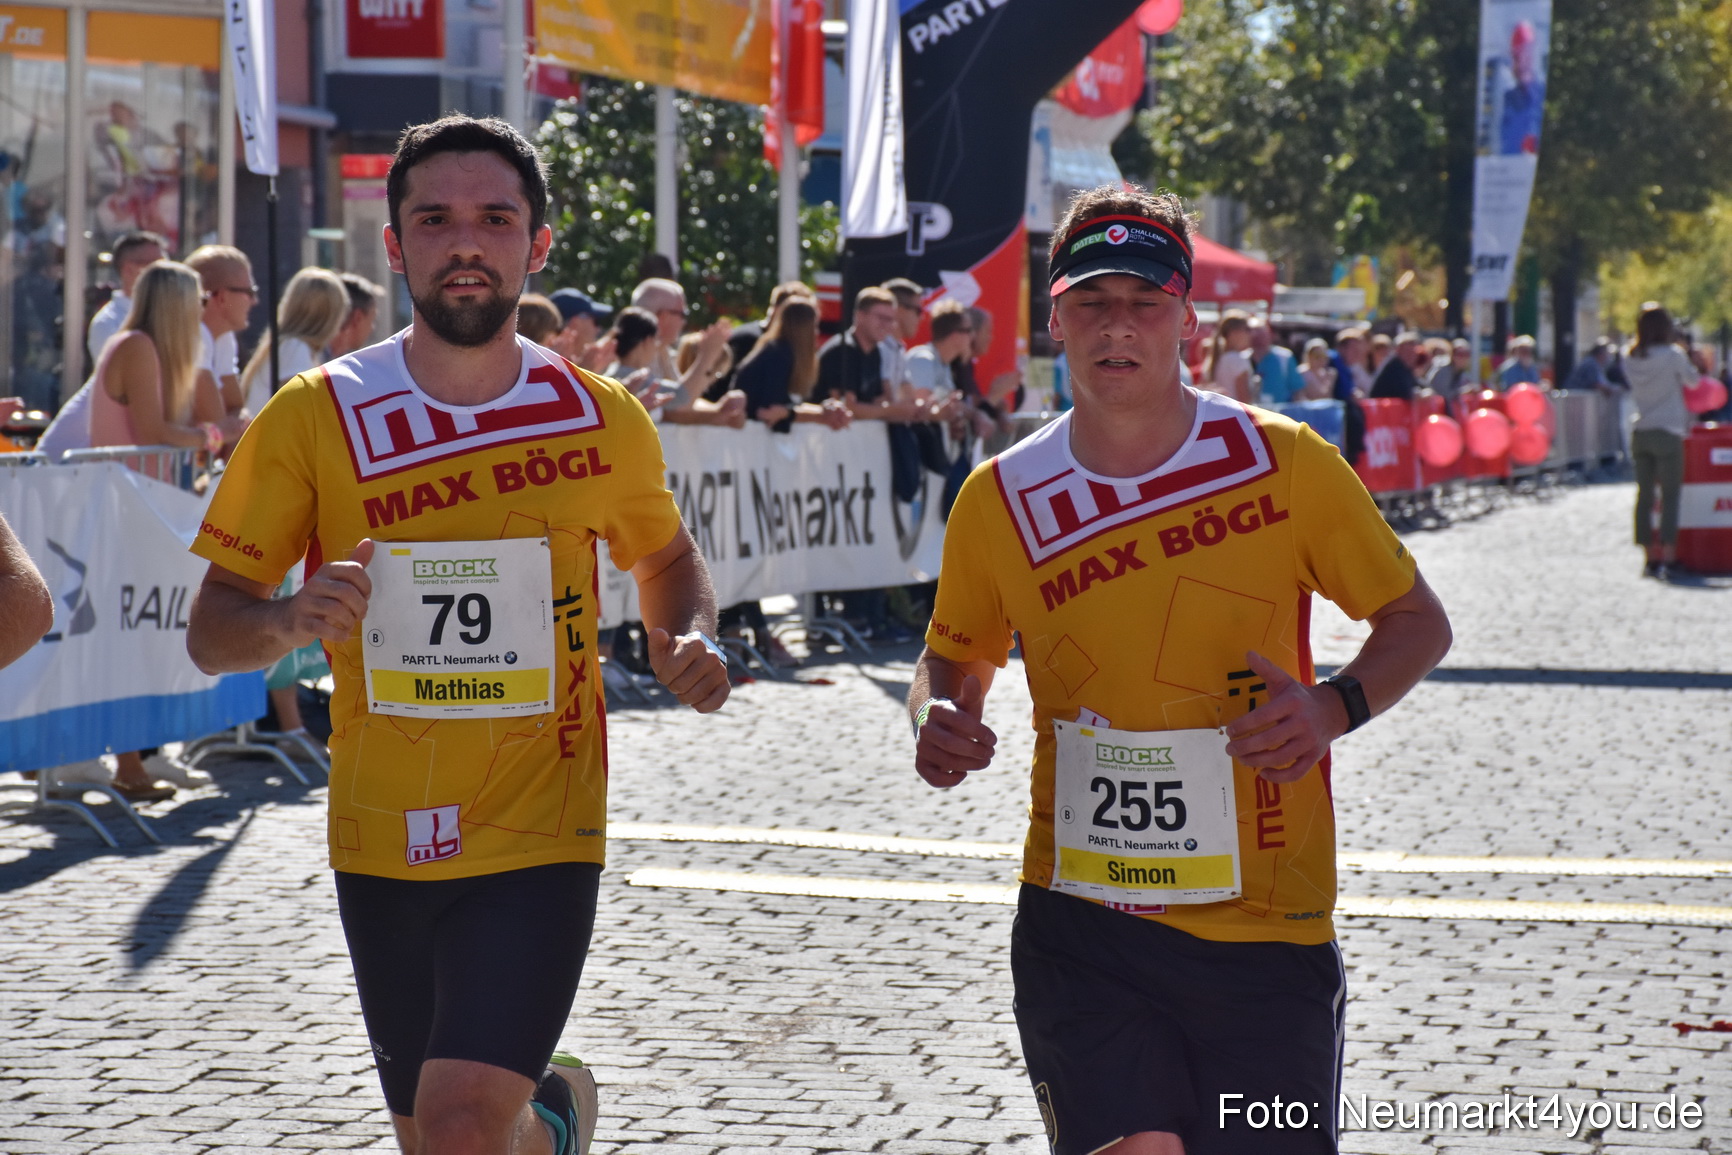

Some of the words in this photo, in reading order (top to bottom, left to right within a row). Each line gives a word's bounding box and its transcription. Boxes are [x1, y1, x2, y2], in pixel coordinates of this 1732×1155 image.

[1073, 233, 1102, 252] DATEV
[1130, 228, 1168, 245] CHALLENGE
[362, 470, 480, 529] MAX
[492, 447, 612, 495] BÖGL
[1039, 540, 1148, 613] MAX
[1157, 493, 1289, 559] BÖGL
[413, 558, 498, 578] BOCK
[413, 578, 439, 586] inspired
[422, 593, 492, 645] 79
[402, 655, 441, 665] PARTL
[443, 654, 500, 665] Neumarkt
[414, 678, 505, 701] Mathias
[1096, 743, 1175, 765] BOCK
[1096, 762, 1118, 771] inspired
[1090, 776, 1187, 831] 255
[1088, 834, 1122, 849] PARTL
[1124, 837, 1179, 850] Neumarkt
[1107, 861, 1176, 884] Simon
